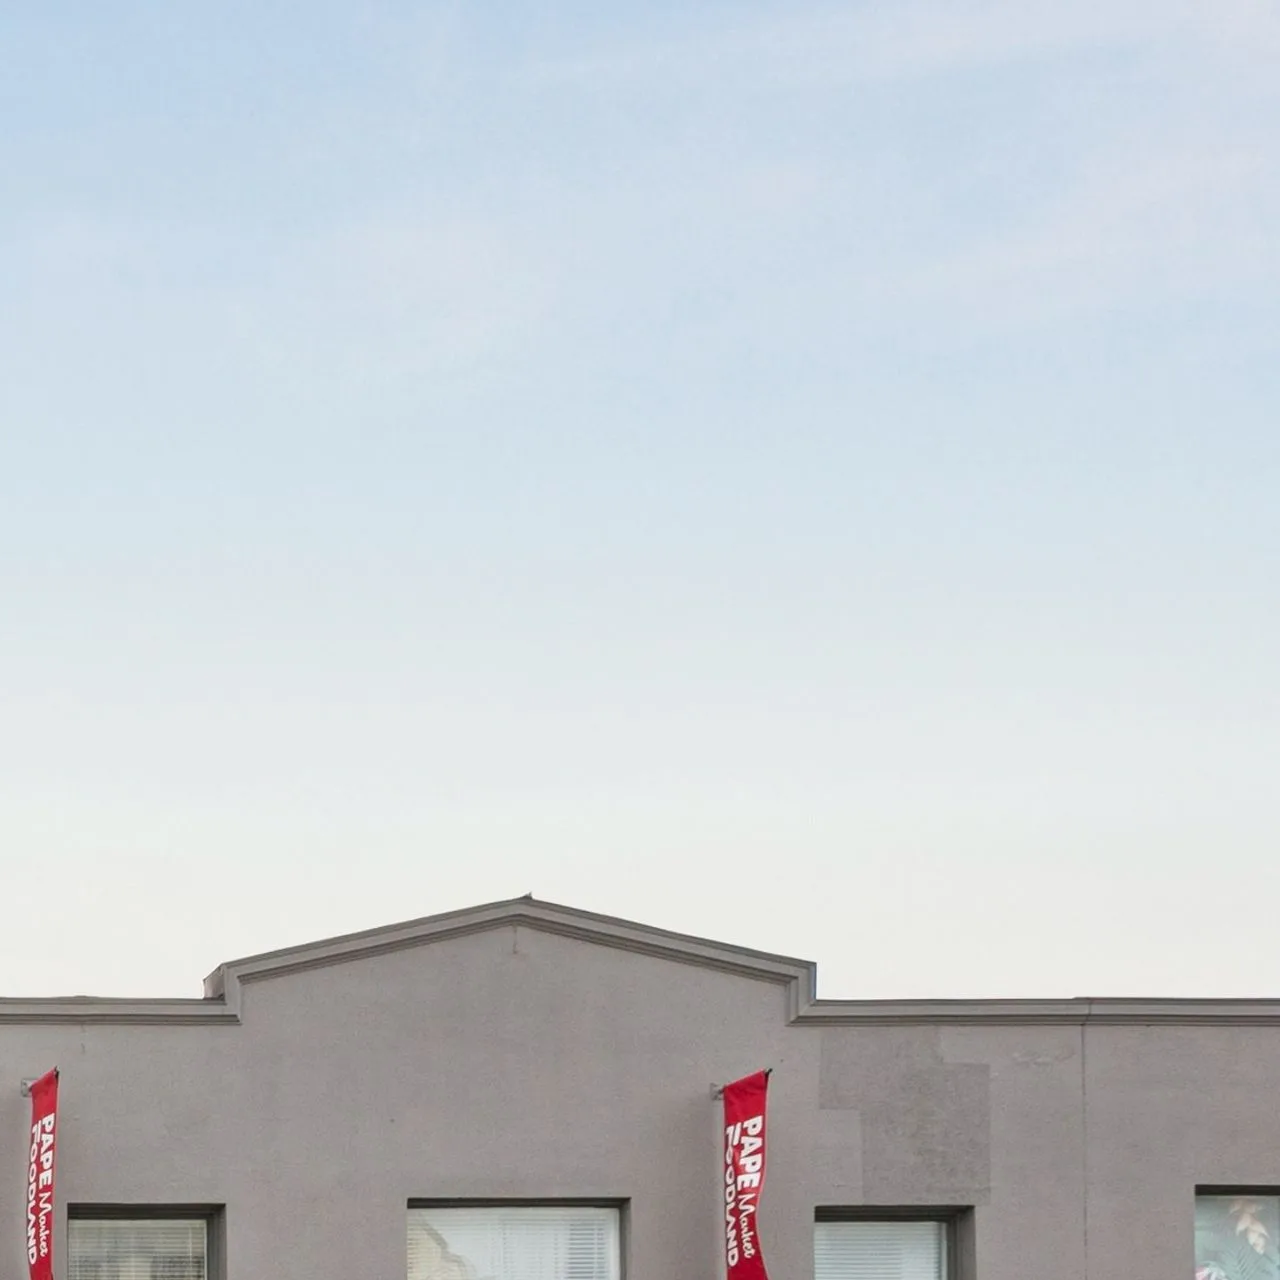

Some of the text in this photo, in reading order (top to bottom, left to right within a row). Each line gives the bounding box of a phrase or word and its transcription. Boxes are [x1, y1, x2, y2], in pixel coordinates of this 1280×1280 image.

[28, 1121, 42, 1264] FOODLAND
[39, 1113, 54, 1256] PAPE Market
[726, 1123, 741, 1267] FOODLAND
[738, 1116, 763, 1258] PAPE Market
